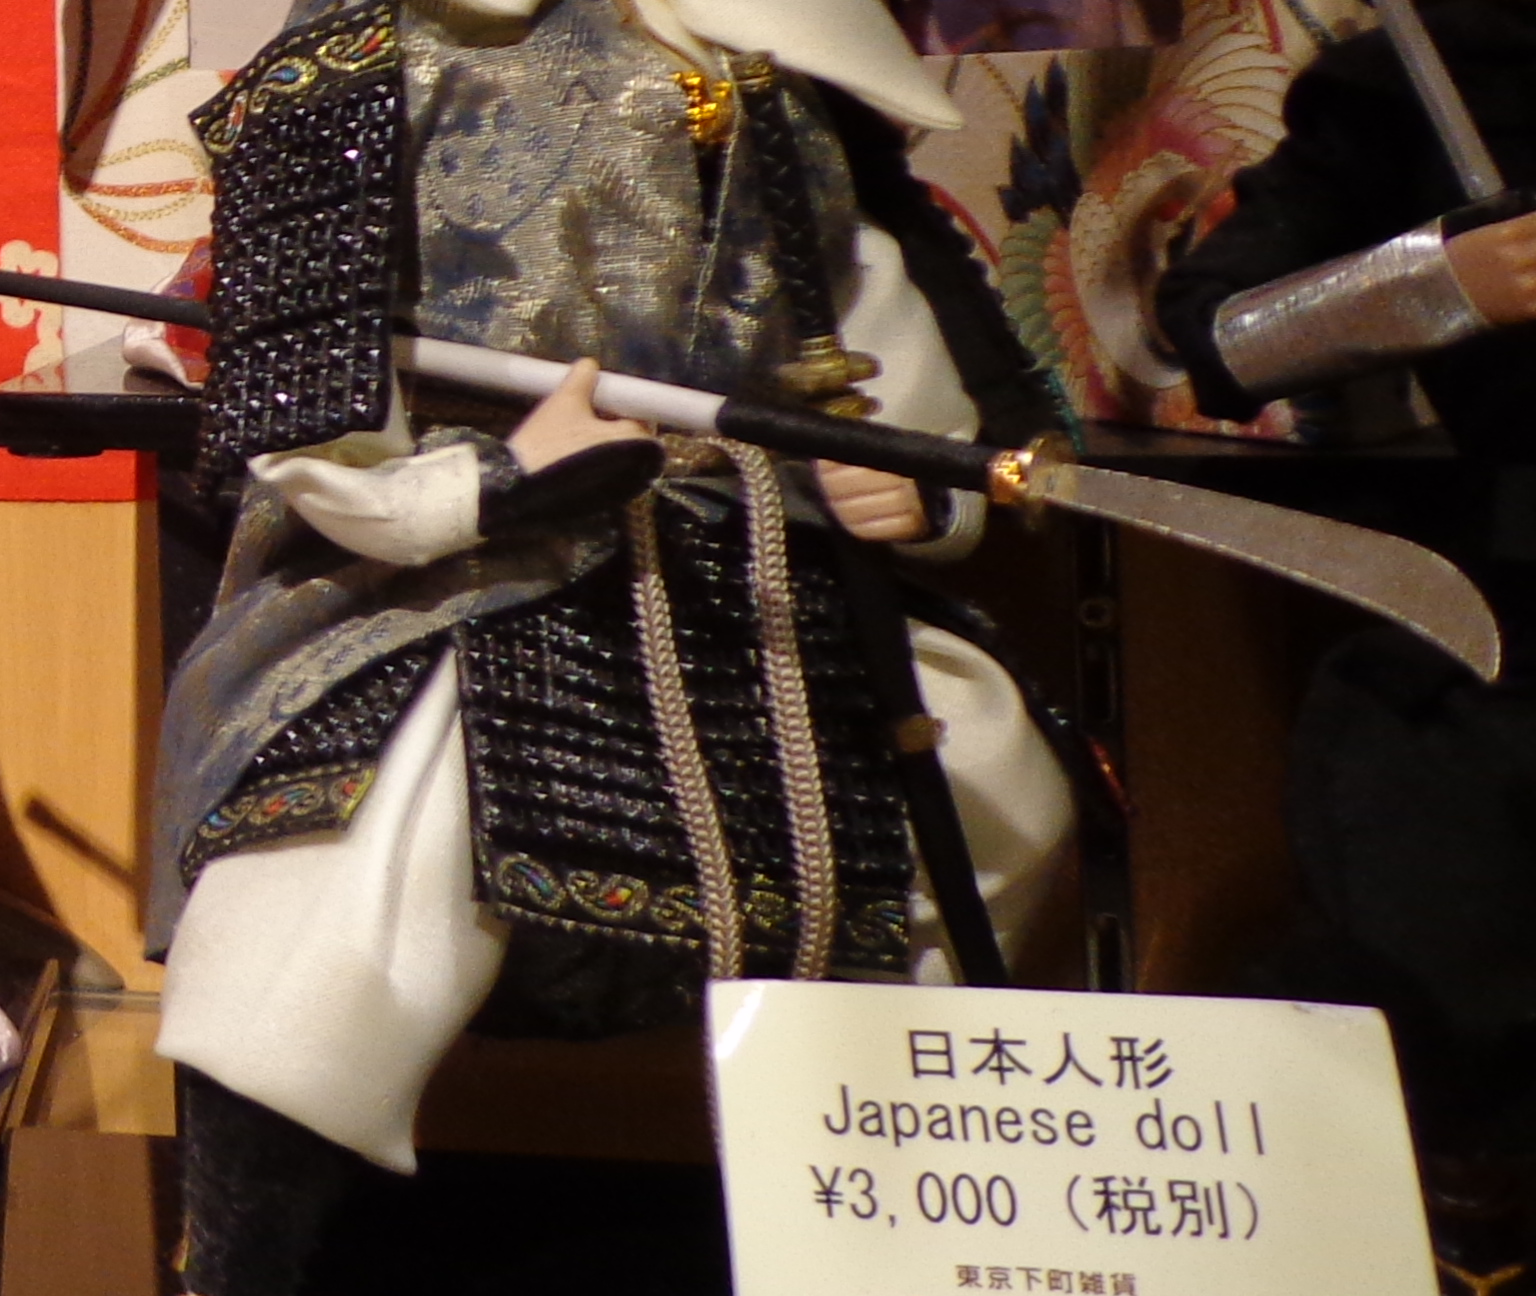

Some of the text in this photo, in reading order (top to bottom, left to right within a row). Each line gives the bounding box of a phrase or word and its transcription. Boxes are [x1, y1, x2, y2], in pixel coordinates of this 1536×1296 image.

[906, 1028, 1177, 1092] 日本人形
[822, 1085, 1269, 1158] Japanese doll
